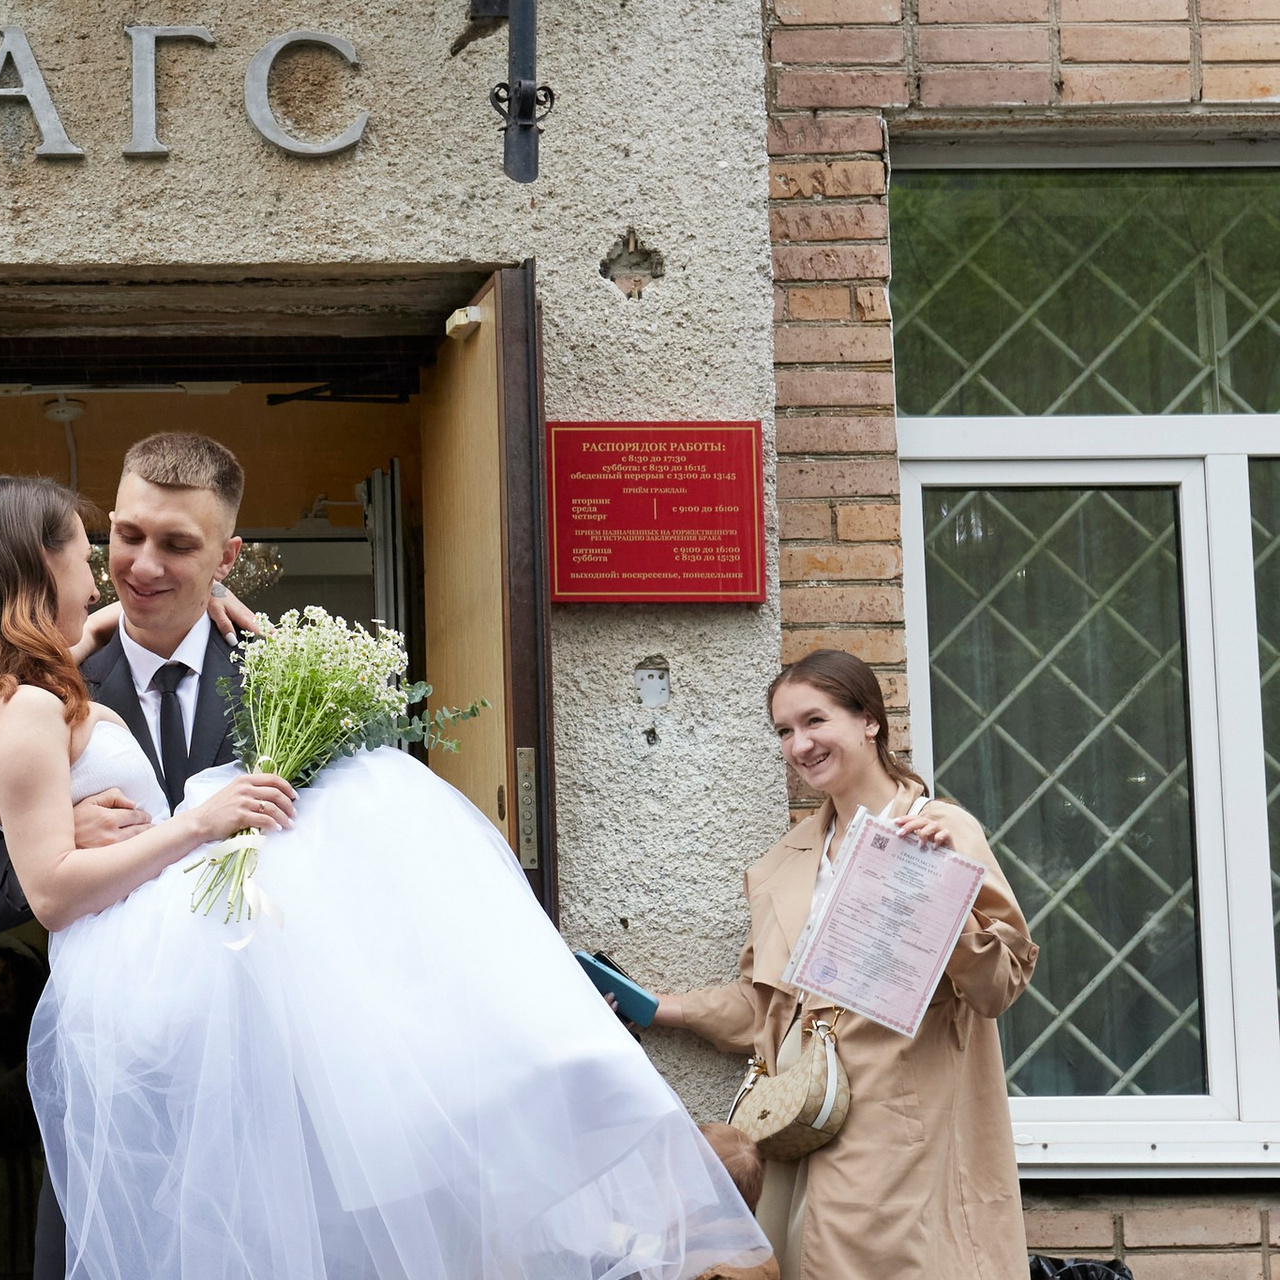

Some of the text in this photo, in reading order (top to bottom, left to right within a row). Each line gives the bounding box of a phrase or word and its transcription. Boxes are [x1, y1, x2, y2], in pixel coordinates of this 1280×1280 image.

[582, 443, 726, 453] РАСПОРЯДОК РАБОТЫ:
[602, 464, 640, 472] суббота:
[570, 472, 622, 480] обеденный
[572, 555, 608, 563] суббота
[570, 571, 619, 579] выходной:
